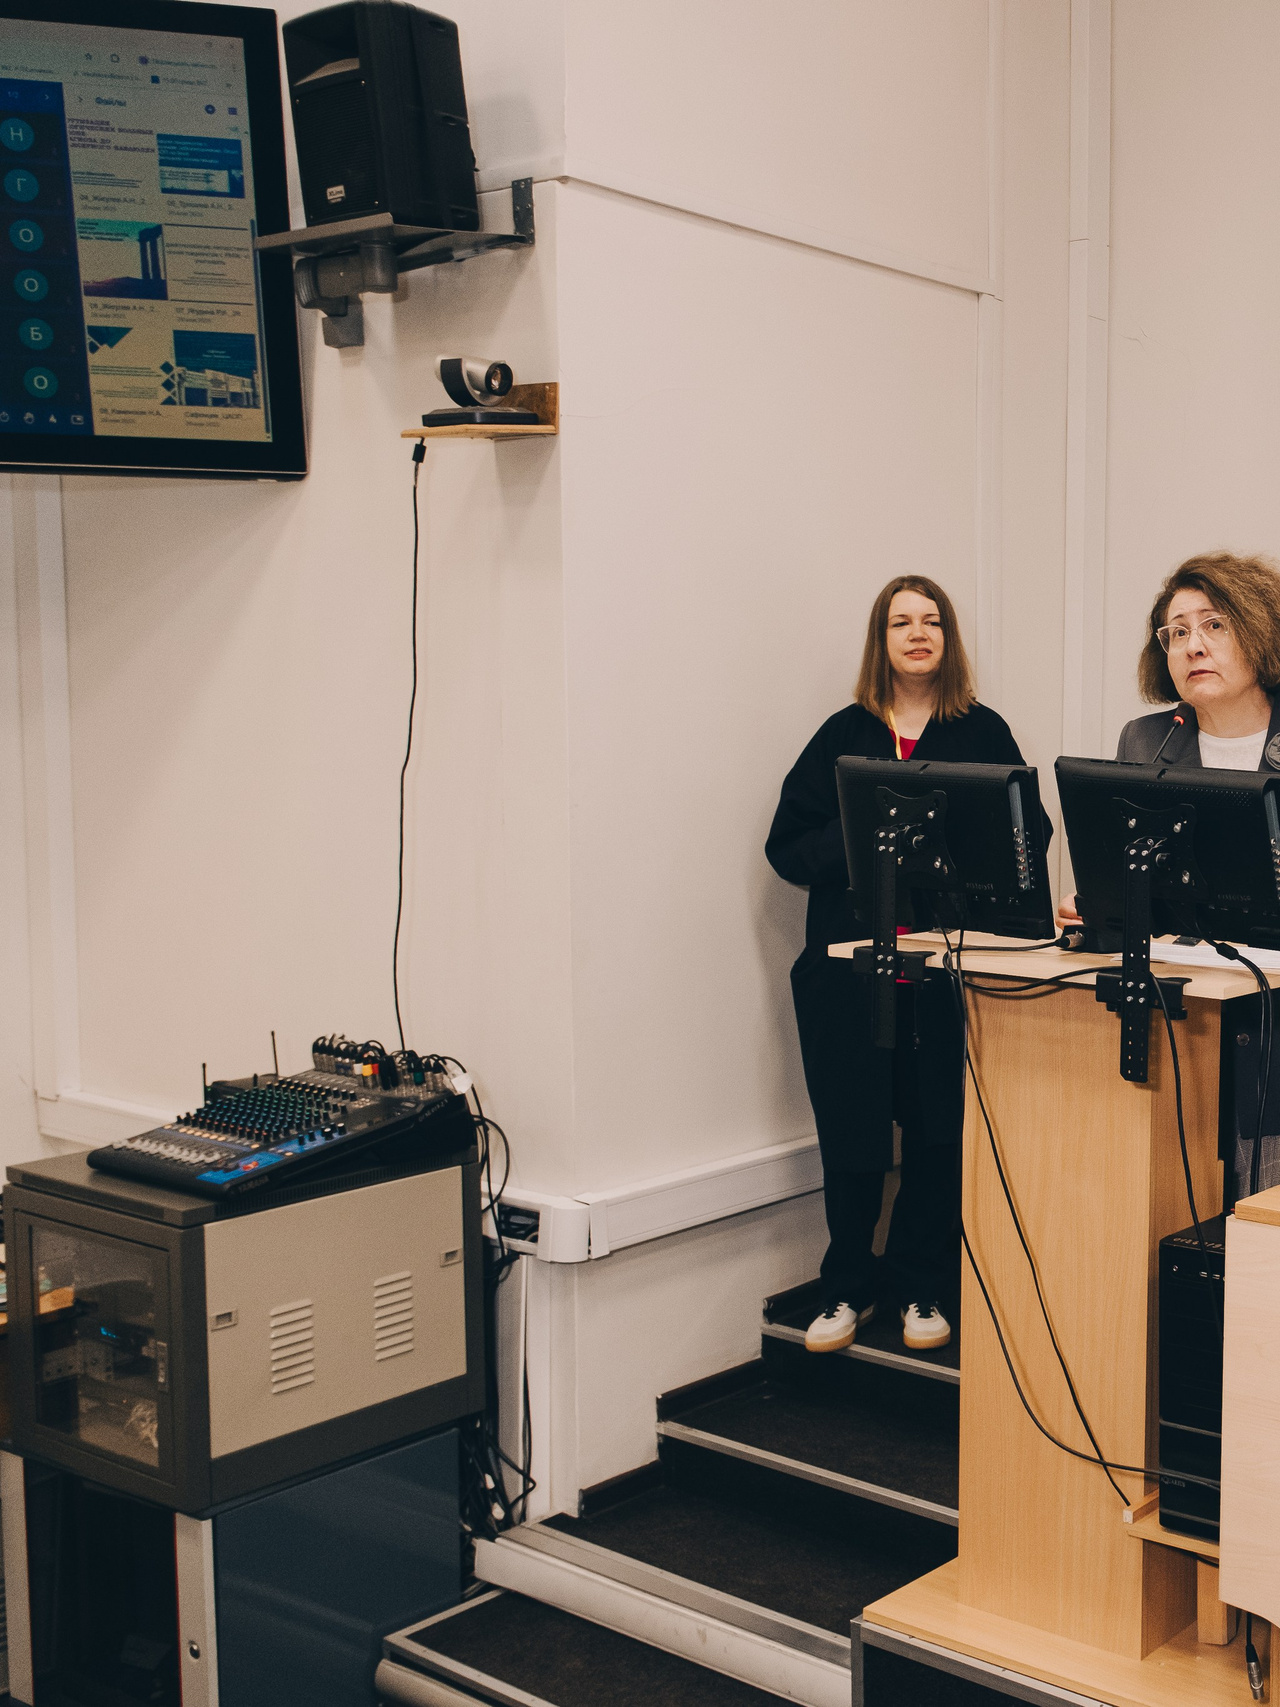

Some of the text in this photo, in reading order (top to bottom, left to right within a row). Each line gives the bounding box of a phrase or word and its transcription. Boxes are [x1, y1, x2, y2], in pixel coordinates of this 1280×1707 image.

[94, 97, 126, 107] Файлы
[10, 127, 24, 142] Н
[17, 178, 26, 192] Г
[19, 228, 34, 243] О
[24, 277, 39, 292] О
[29, 326, 43, 341] Б
[33, 375, 48, 390] О
